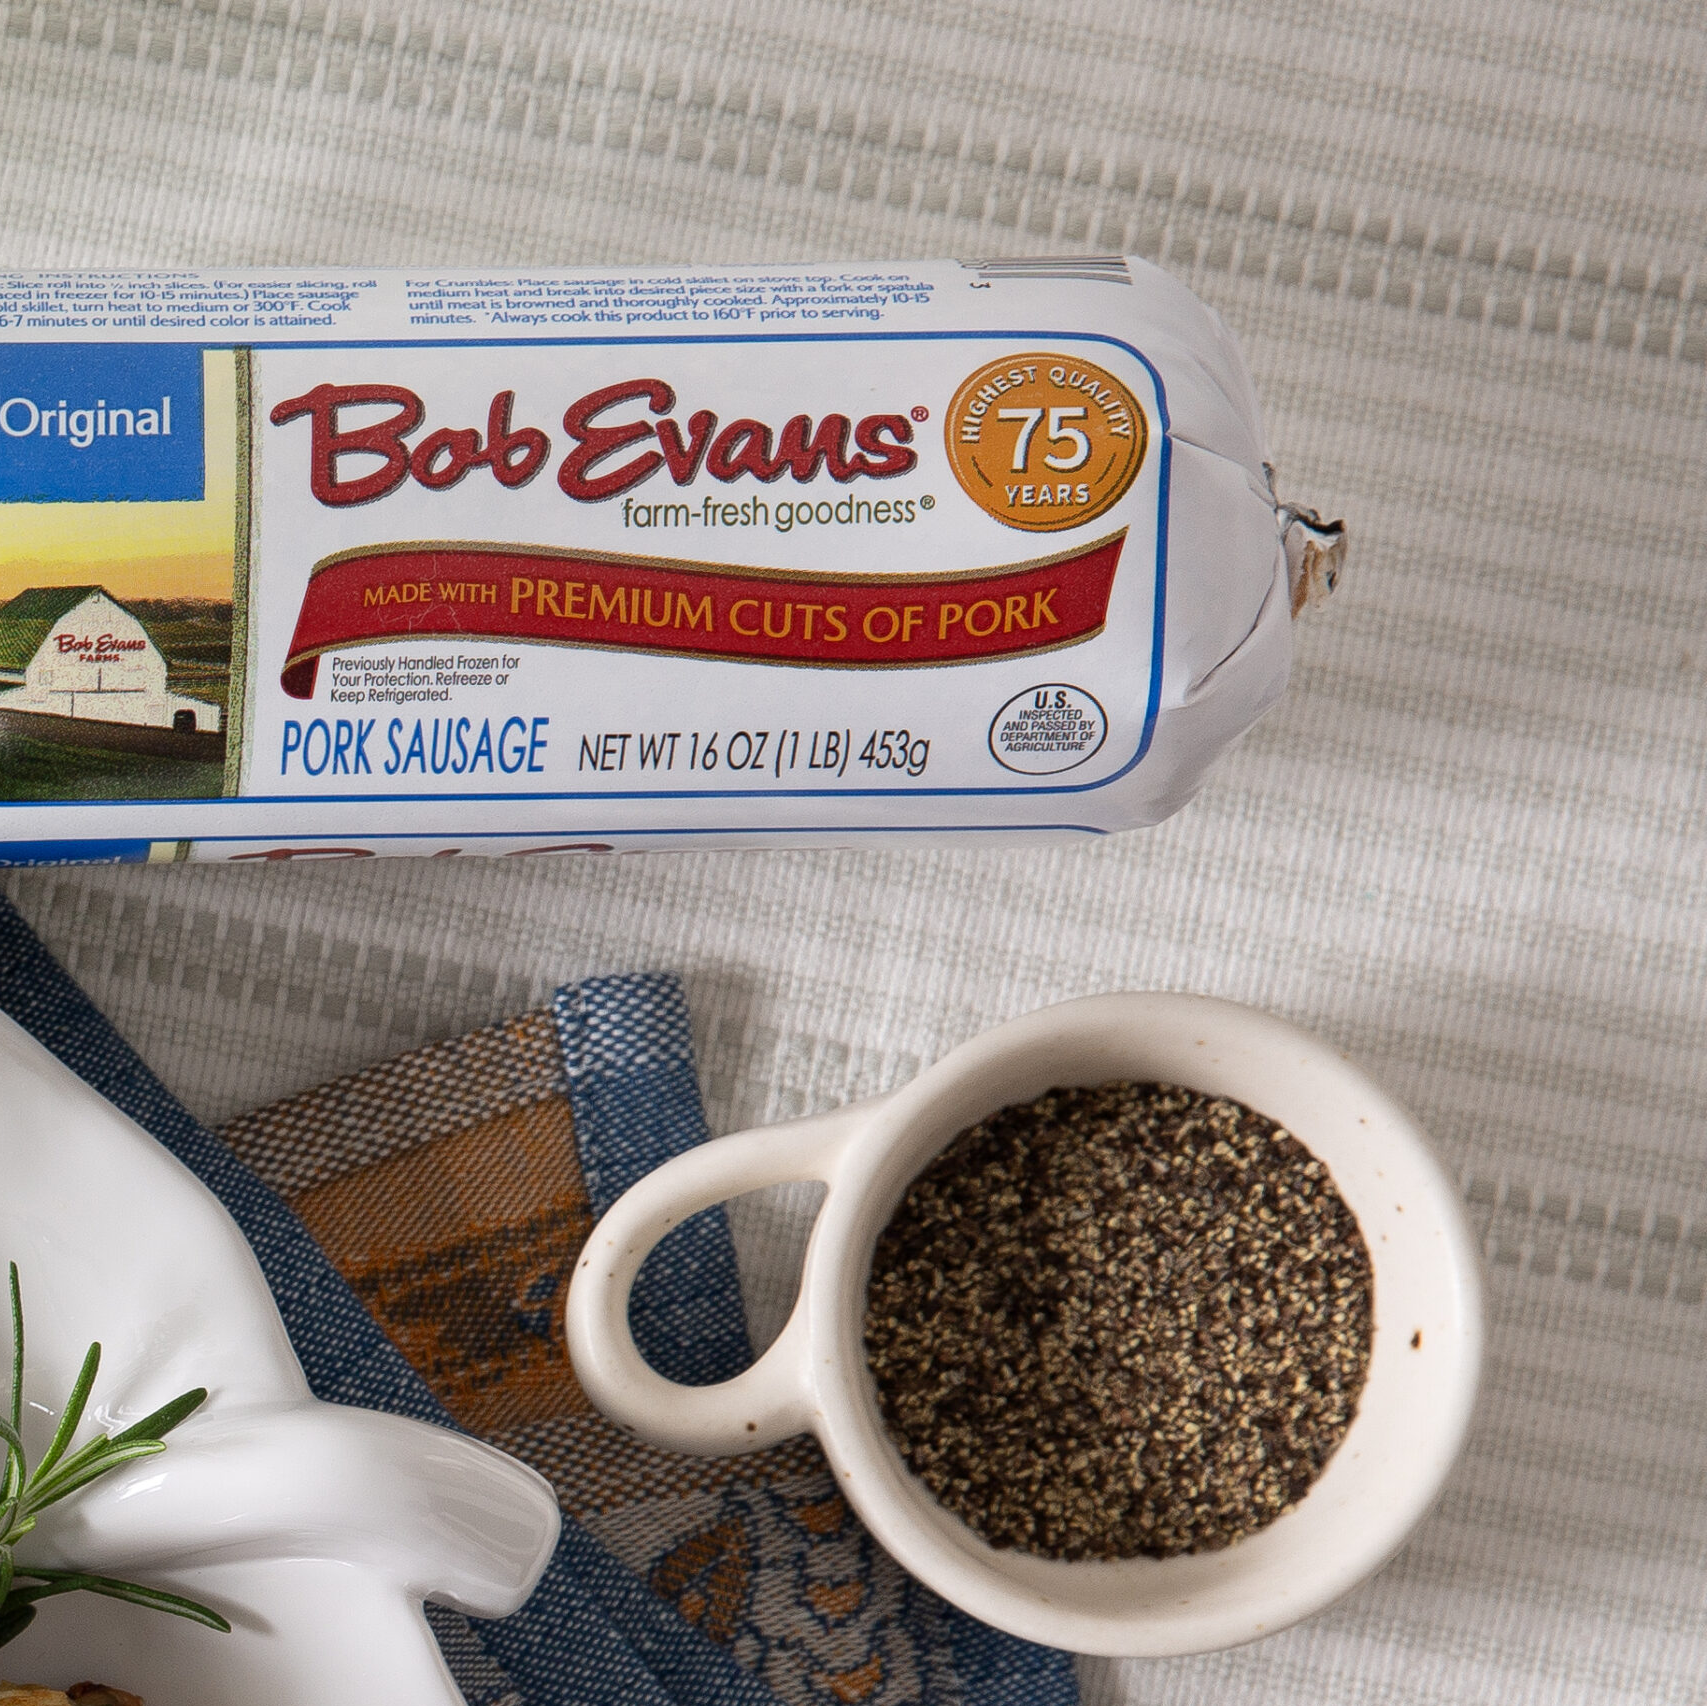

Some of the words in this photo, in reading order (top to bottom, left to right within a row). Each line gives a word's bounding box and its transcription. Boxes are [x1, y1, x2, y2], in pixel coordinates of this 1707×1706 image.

[7, 281, 43, 289] Slice
[48, 281, 71, 289] roll
[76, 281, 105, 289] into
[128, 281, 161, 289] inch
[248, 281, 291, 289] easier
[352, 280, 378, 288] roll
[38, 272, 200, 280] INSTRUCTIONS
[405, 279, 431, 288] For
[518, 278, 560, 287] Place
[564, 279, 624, 287] sausage
[629, 277, 644, 285] in
[648, 277, 681, 285] cold
[840, 274, 884, 282] Cook
[37, 290, 49, 300] in
[54, 290, 108, 300] freezer
[113, 290, 135, 300] for
[140, 290, 176, 300] 10-15
[252, 289, 294, 299] Place
[297, 290, 359, 301] sausage
[408, 289, 470, 298] medium
[475, 288, 509, 297] heat
[514, 287, 542, 297] and
[547, 287, 590, 296] break
[595, 287, 625, 296] into
[629, 285, 685, 295] desired
[690, 285, 731, 296] piece
[736, 284, 765, 294] size
[770, 283, 802, 293] with
[807, 285, 816, 293] a
[820, 283, 853, 292] fork
[857, 284, 873, 292] or
[878, 282, 934, 293] spatula
[21, 301, 69, 315] skillet,
[72, 302, 104, 312] turn
[108, 301, 141, 312] heat
[146, 302, 163, 312] to
[167, 300, 229, 312] medium
[233, 302, 250, 312] or
[307, 299, 352, 311] Cook
[409, 299, 443, 310] until
[447, 300, 486, 310] meat
[490, 298, 503, 309] is
[506, 298, 575, 309] browned
[580, 297, 609, 308] and
[613, 295, 699, 308] thoroughly
[703, 294, 766, 306] cooked.
[772, 294, 888, 307] Approximately
[892, 293, 930, 304] 10-15
[27, 314, 89, 327] minutes
[92, 316, 108, 327] or
[113, 314, 146, 327] until
[150, 314, 206, 327] desired
[210, 314, 250, 327] color
[254, 314, 266, 326] is
[270, 313, 337, 326] attained.
[410, 312, 476, 324] minutes.
[551, 310, 592, 323] cook
[595, 309, 623, 322] this
[626, 308, 688, 324] product
[692, 310, 709, 320] to
[760, 307, 797, 322] prior
[801, 308, 818, 319] to
[822, 307, 885, 320] serving.
[960, 365, 1038, 444] HIGHEST
[1048, 365, 1132, 440] QUALITY
[270, 382, 552, 509] Bob
[997, 406, 1093, 473] 75
[1004, 483, 1091, 507] YEARS
[622, 496, 769, 529] farm-fresh
[363, 582, 432, 607] MADE
[438, 582, 498, 604] WITH
[509, 576, 715, 632] PREMIUM
[729, 599, 848, 642] CUTS
[862, 605, 924, 642] OF
[937, 588, 1060, 641] PORK
[53, 633, 94, 653] Bob
[95, 633, 147, 653] Evans
[332, 656, 394, 673] Previously
[398, 655, 455, 670] Handled
[457, 655, 499, 670] Frozen
[501, 654, 520, 670] for
[331, 673, 362, 687] Your
[364, 671, 434, 687] Protection.
[436, 671, 492, 686] Refreeze
[495, 674, 509, 686] or
[330, 688, 366, 704] Keep
[368, 687, 453, 705] Refrigerated.
[1035, 690, 1072, 709] U.S.
[1019, 708, 1083, 721] INSPECTED
[1003, 720, 1028, 731] AND
[1031, 720, 1076, 731] PASSED
[1078, 719, 1096, 730] BY
[1000, 731, 1078, 742] DEPARTMENT
[1080, 730, 1096, 741] OF
[280, 718, 377, 776] PORK
[383, 716, 550, 775] SAUSAGE
[578, 733, 632, 772] NET
[639, 731, 682, 770] WT
[690, 730, 719, 770] 16
[727, 730, 770, 770] OZ
[774, 729, 800, 778] (1
[808, 728, 850, 777] LB)
[858, 728, 931, 777] 453g
[1005, 741, 1086, 752] AGRICULTURE
